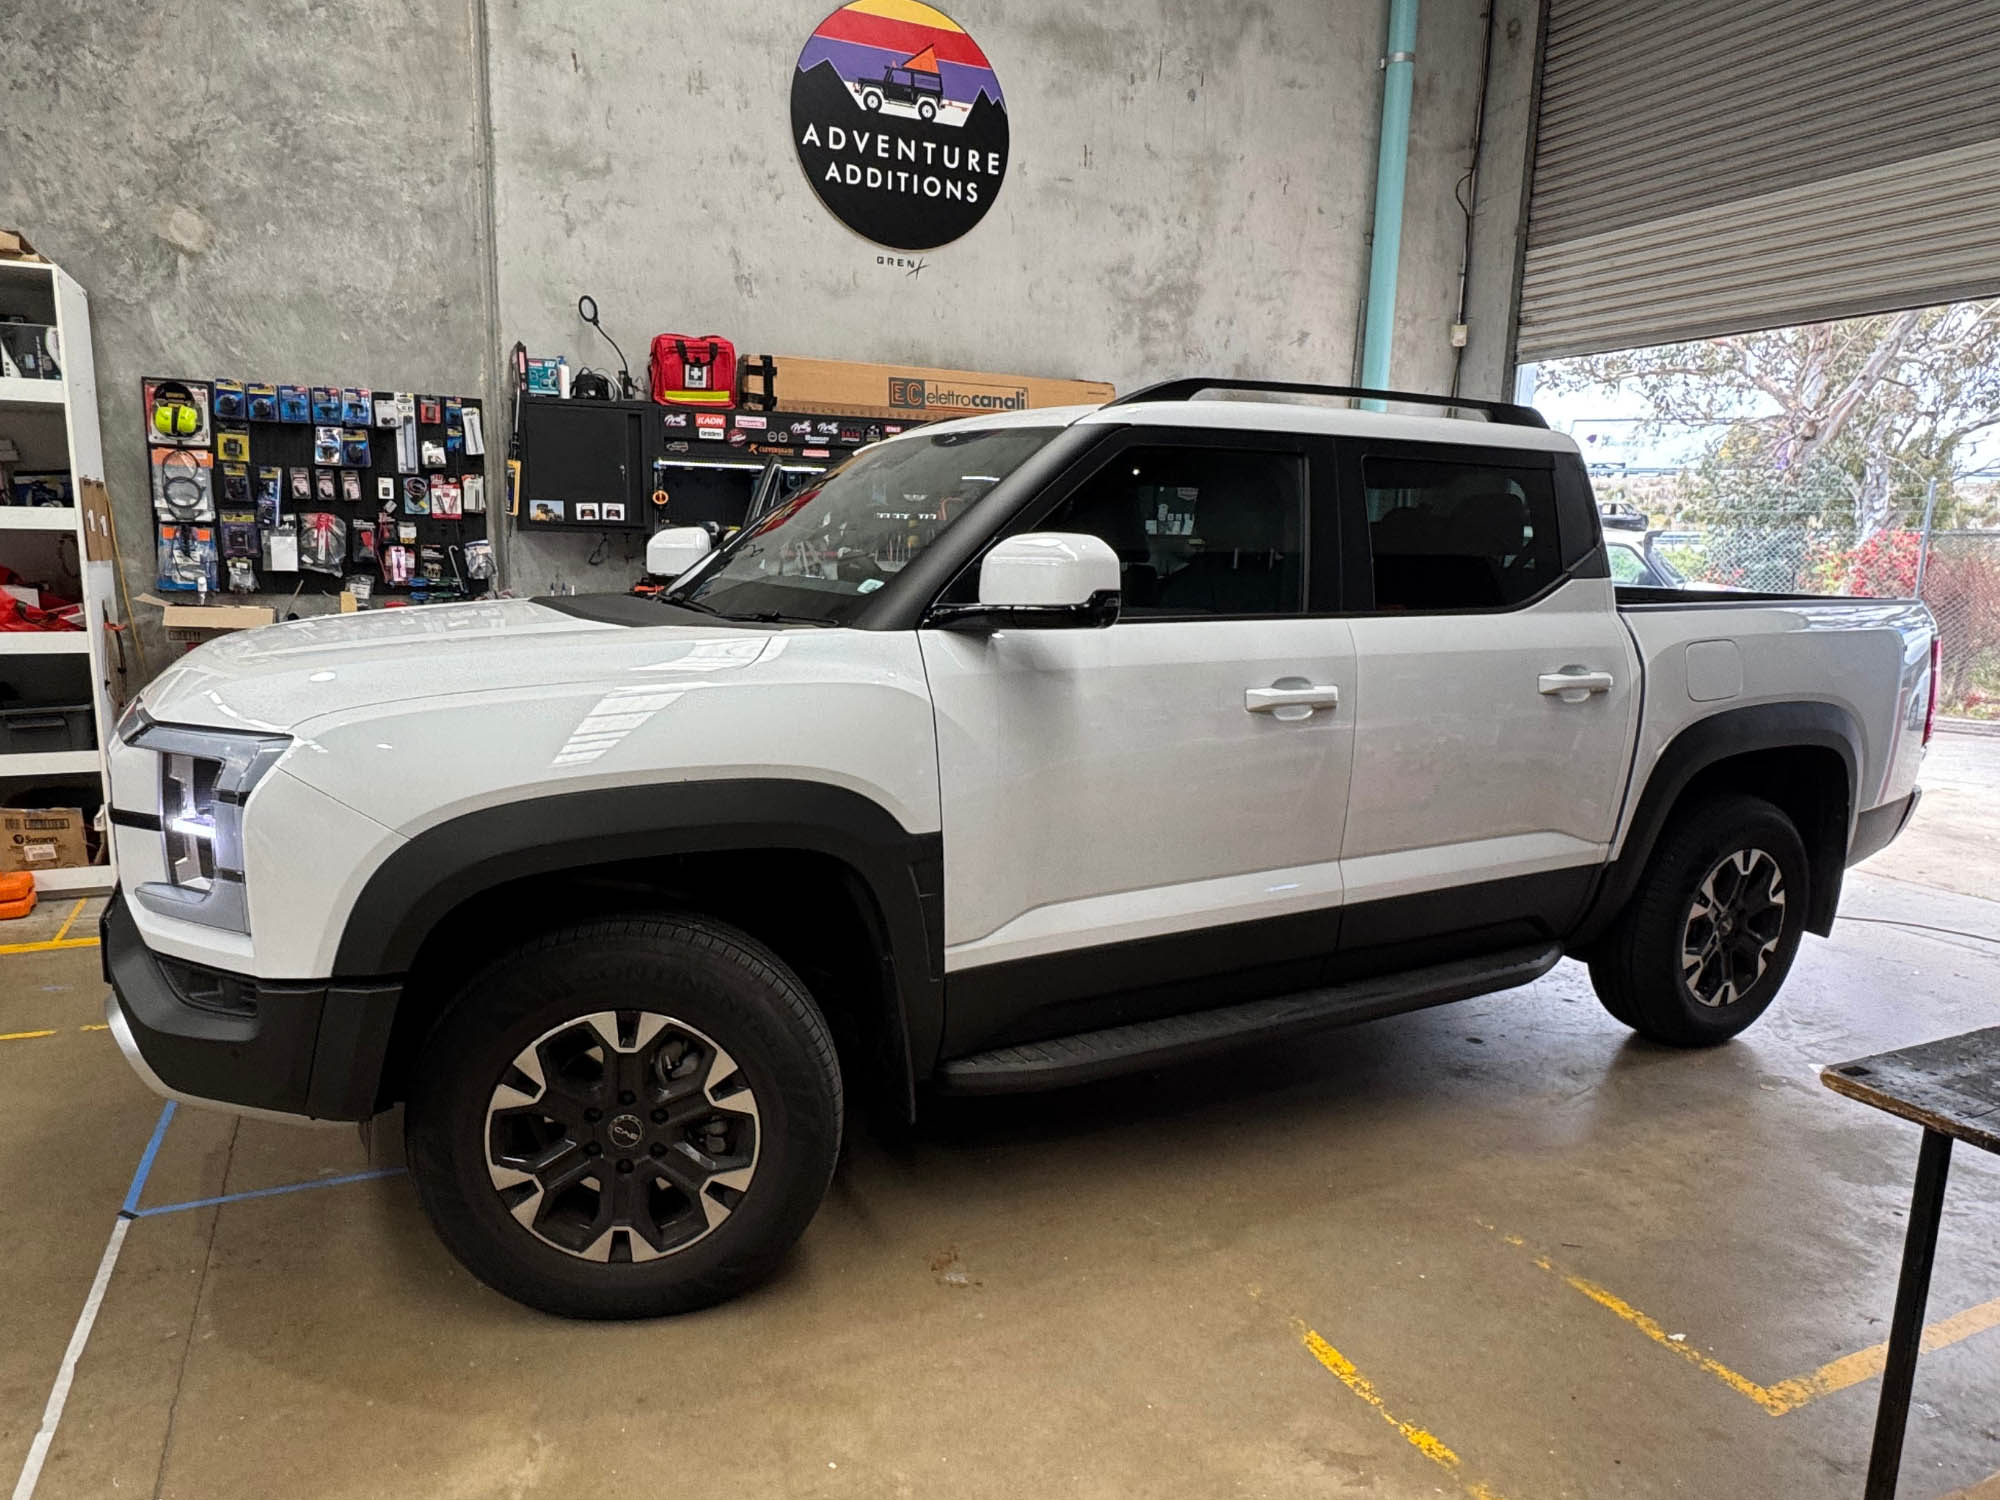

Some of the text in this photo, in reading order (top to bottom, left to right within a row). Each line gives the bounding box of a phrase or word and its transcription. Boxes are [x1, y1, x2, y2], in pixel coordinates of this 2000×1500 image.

[802, 123, 1001, 175] ADVENTURE
[825, 161, 979, 203] ADDITIONS
[926, 383, 1025, 410] elettrocanali
